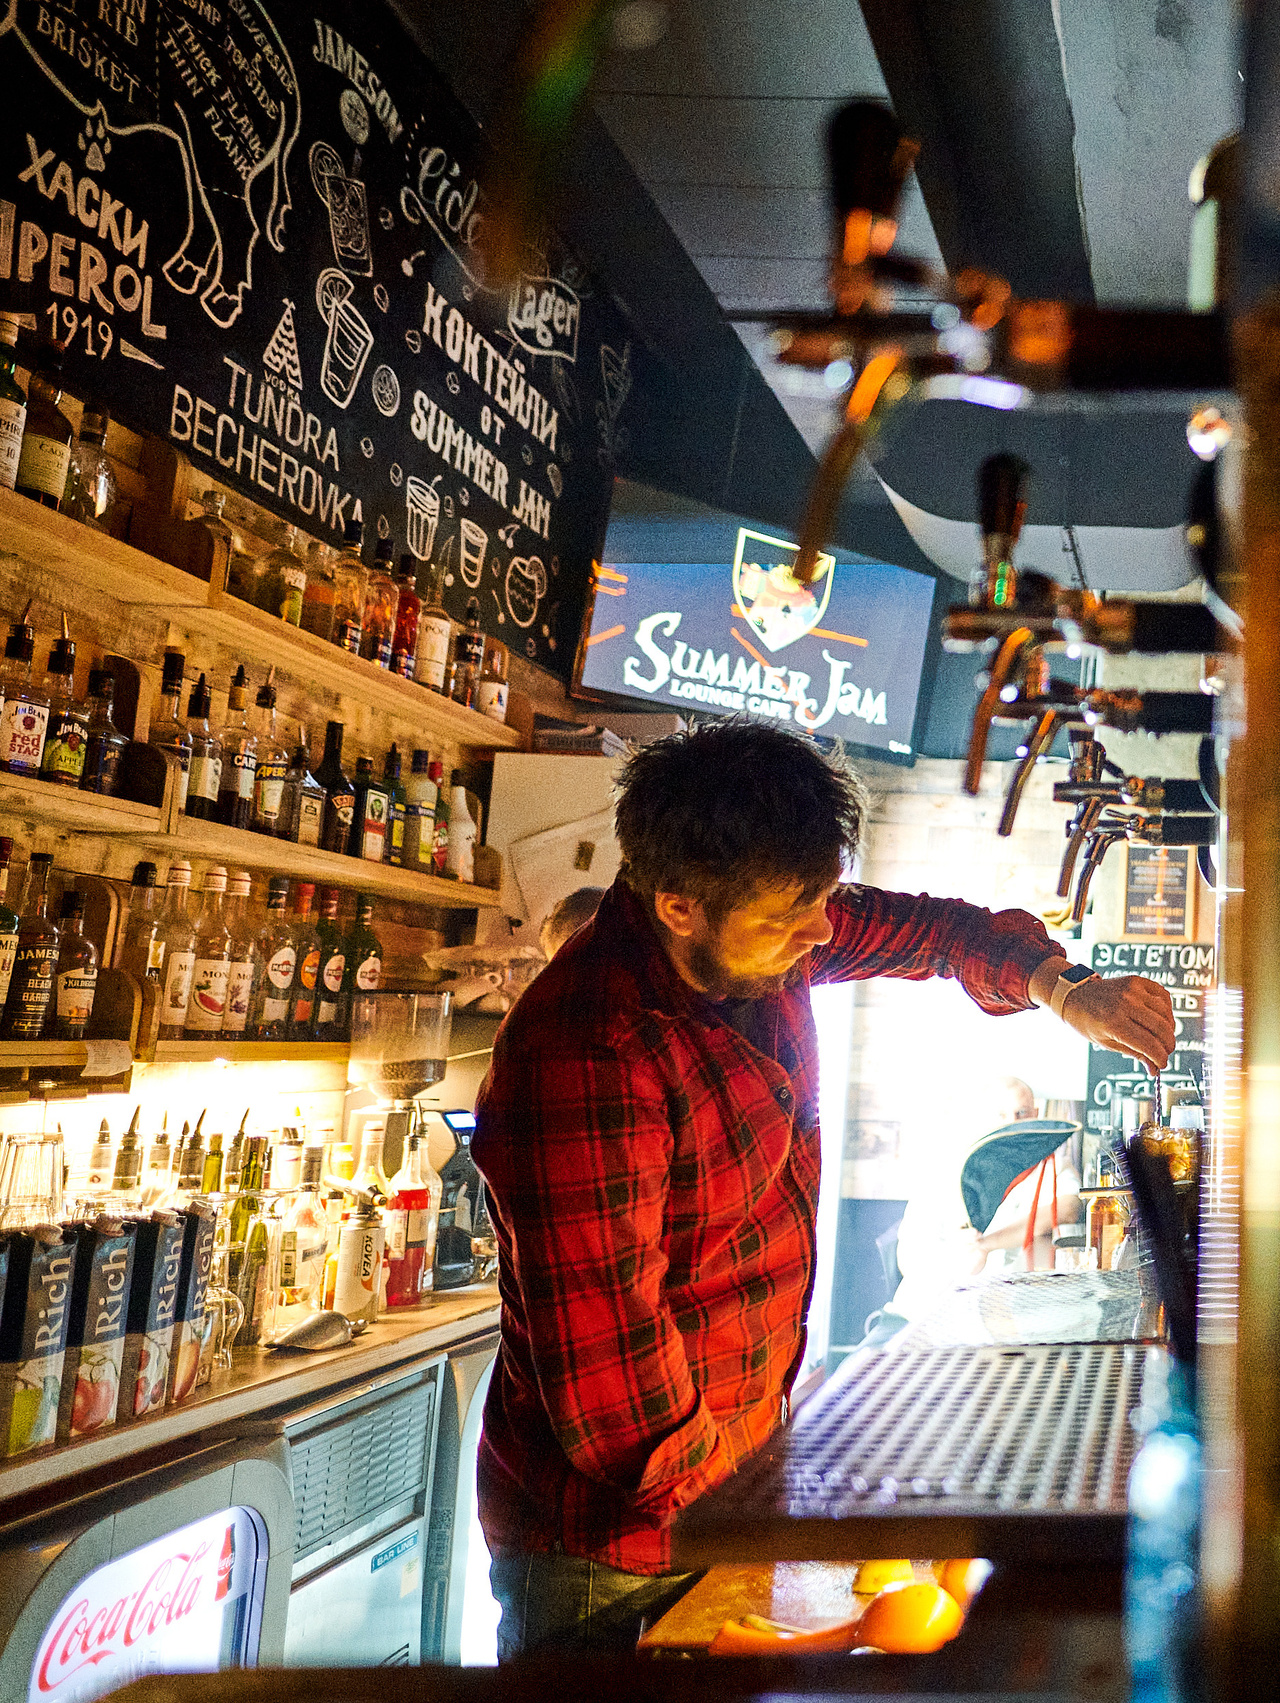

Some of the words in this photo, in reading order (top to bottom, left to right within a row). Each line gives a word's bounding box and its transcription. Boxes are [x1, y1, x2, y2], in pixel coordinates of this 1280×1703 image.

[36, 4, 140, 103] BRISKET
[177, 15, 222, 88] THICK
[312, 17, 402, 144] JAMESON
[162, 31, 204, 98] THIN
[203, 103, 255, 181] FLANK
[18, 132, 149, 269] ХАСКИ
[46, 301, 113, 360] 1919
[511, 282, 580, 349] Lager
[223, 355, 340, 472] TUNDRA
[422, 282, 558, 455] КОКТЕЙЛИ
[409, 388, 510, 509] SUMMER
[512, 479, 551, 541] JAM
[623, 611, 812, 703] SUMMER
[669, 677, 747, 710] LOUNGE
[9, 743, 40, 757] STAG
[11, 732, 41, 748] red
[1094, 943, 1214, 969] ЭСТЕТОМ
[95, 1245, 128, 1336] Rich
[155, 1239, 184, 1323] Rich
[192, 1221, 215, 1314] Rich
[361, 1234, 374, 1278] KOVEA
[34, 1256, 71, 1350] Rich
[376, 1548, 395, 1567] BAR
[396, 1537, 415, 1554] LINE
[37, 1540, 215, 1693] Coca-Cola
